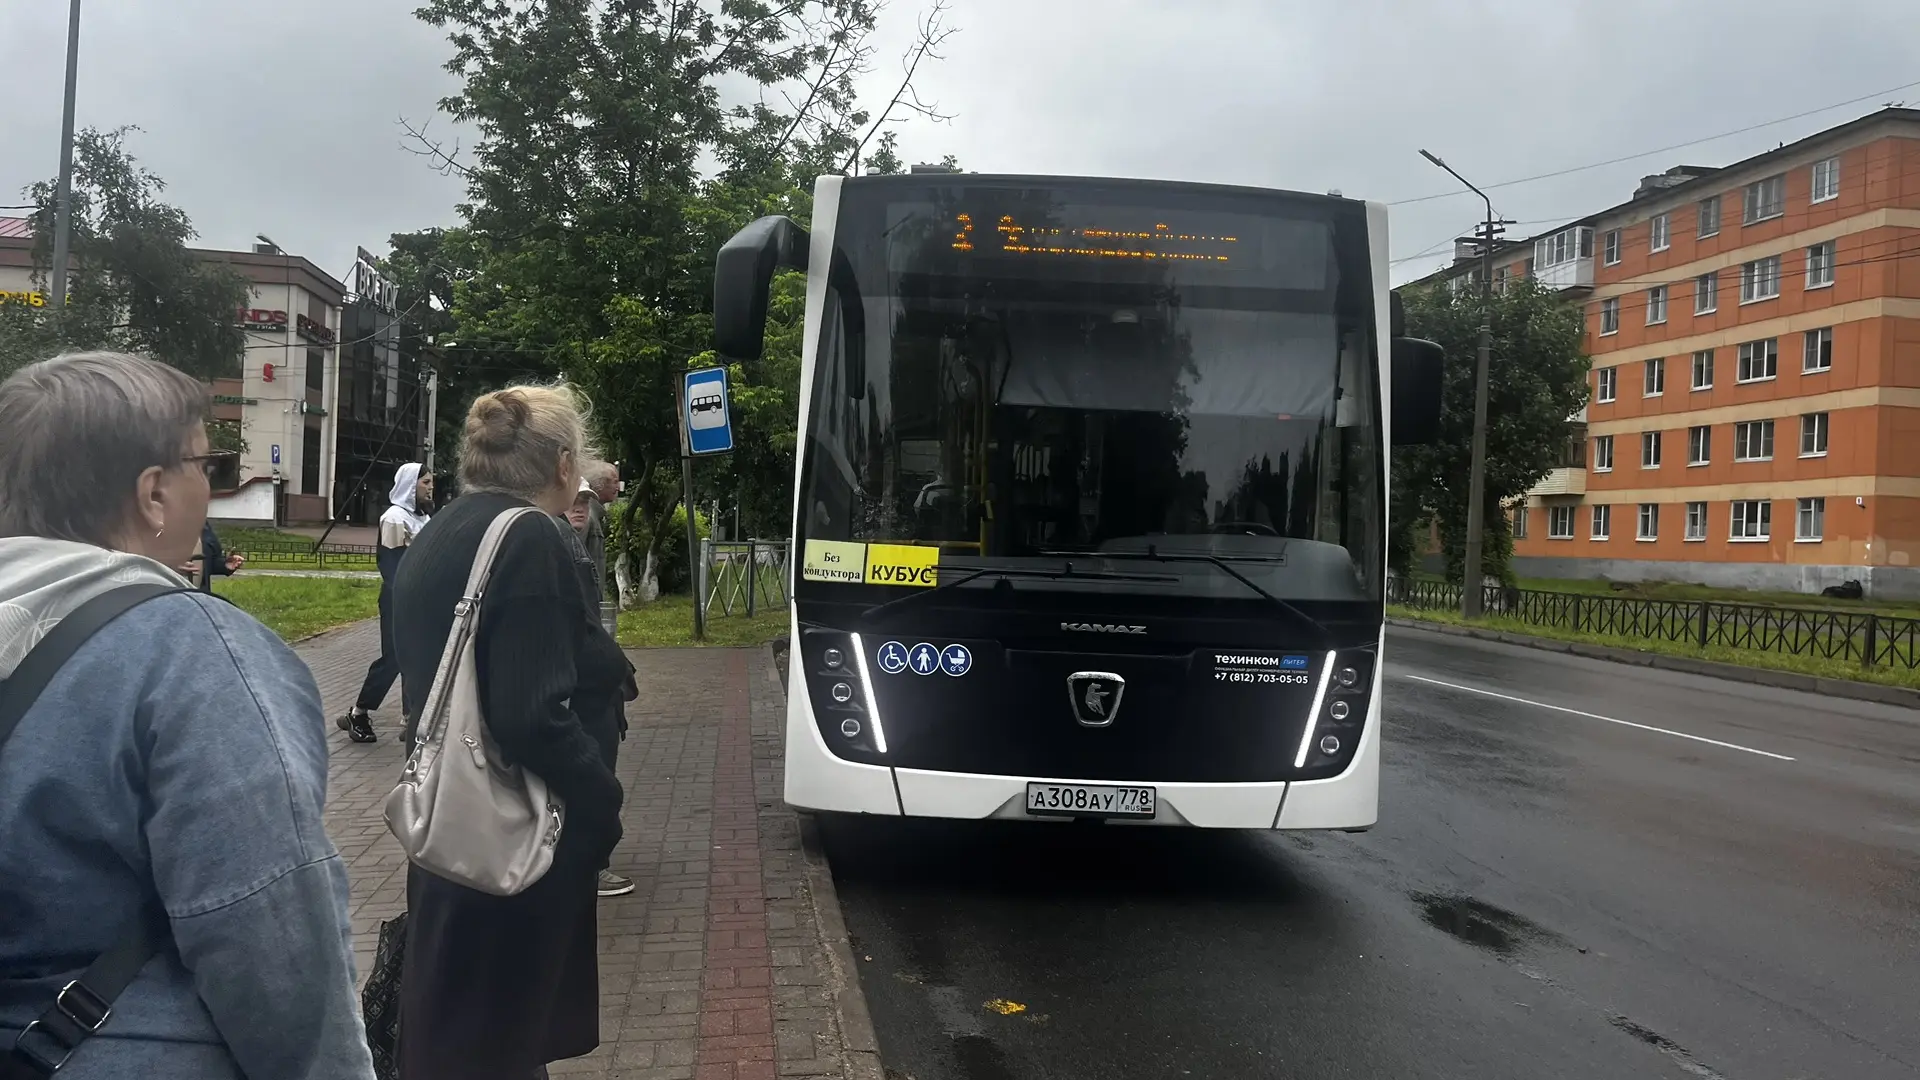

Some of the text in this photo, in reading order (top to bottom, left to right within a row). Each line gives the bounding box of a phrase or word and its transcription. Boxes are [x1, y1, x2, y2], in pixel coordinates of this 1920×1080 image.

[824, 552, 840, 563] Без
[804, 567, 860, 581] кондуктора
[871, 565, 932, 583] КУБУС
[1061, 622, 1147, 634] KAMAZ
[1215, 672, 1308, 684] +7 (812) 703-05-05
[1034, 787, 1149, 810] А308АУ 778
